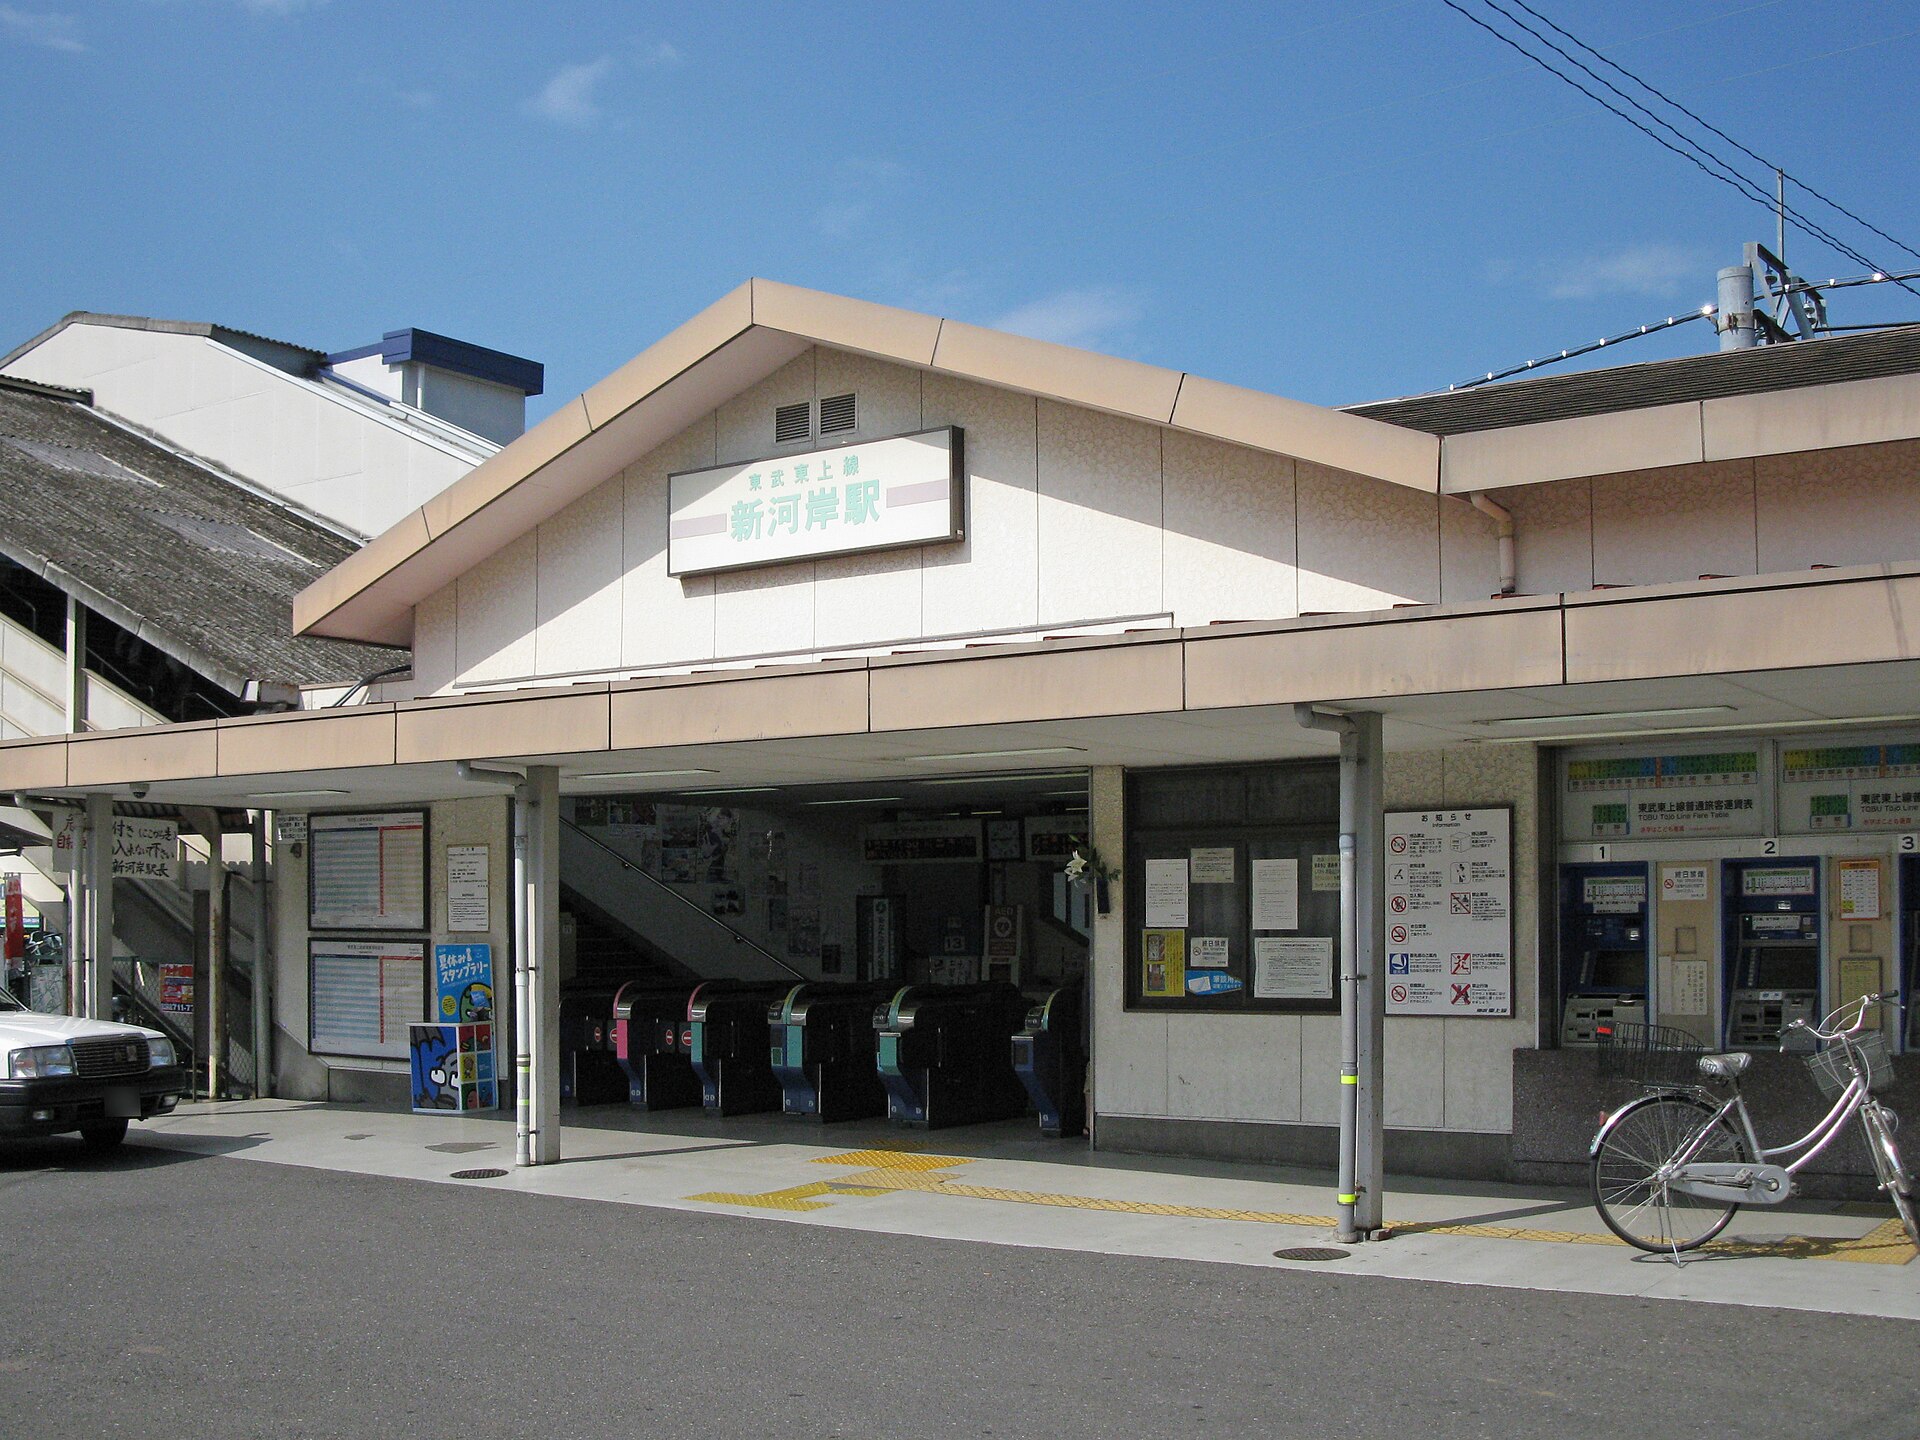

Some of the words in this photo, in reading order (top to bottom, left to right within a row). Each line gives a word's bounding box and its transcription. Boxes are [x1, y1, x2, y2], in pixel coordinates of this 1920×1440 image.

[748, 455, 860, 491] 東武東上線
[730, 478, 880, 543] 新河岸駅
[1421, 813, 1472, 822] お知らせ
[1764, 840, 1776, 854] 2
[1902, 836, 1914, 849] 3
[1598, 846, 1606, 860] 1
[438, 952, 466, 972] 夏休み
[441, 961, 489, 984] スタンプラリー
